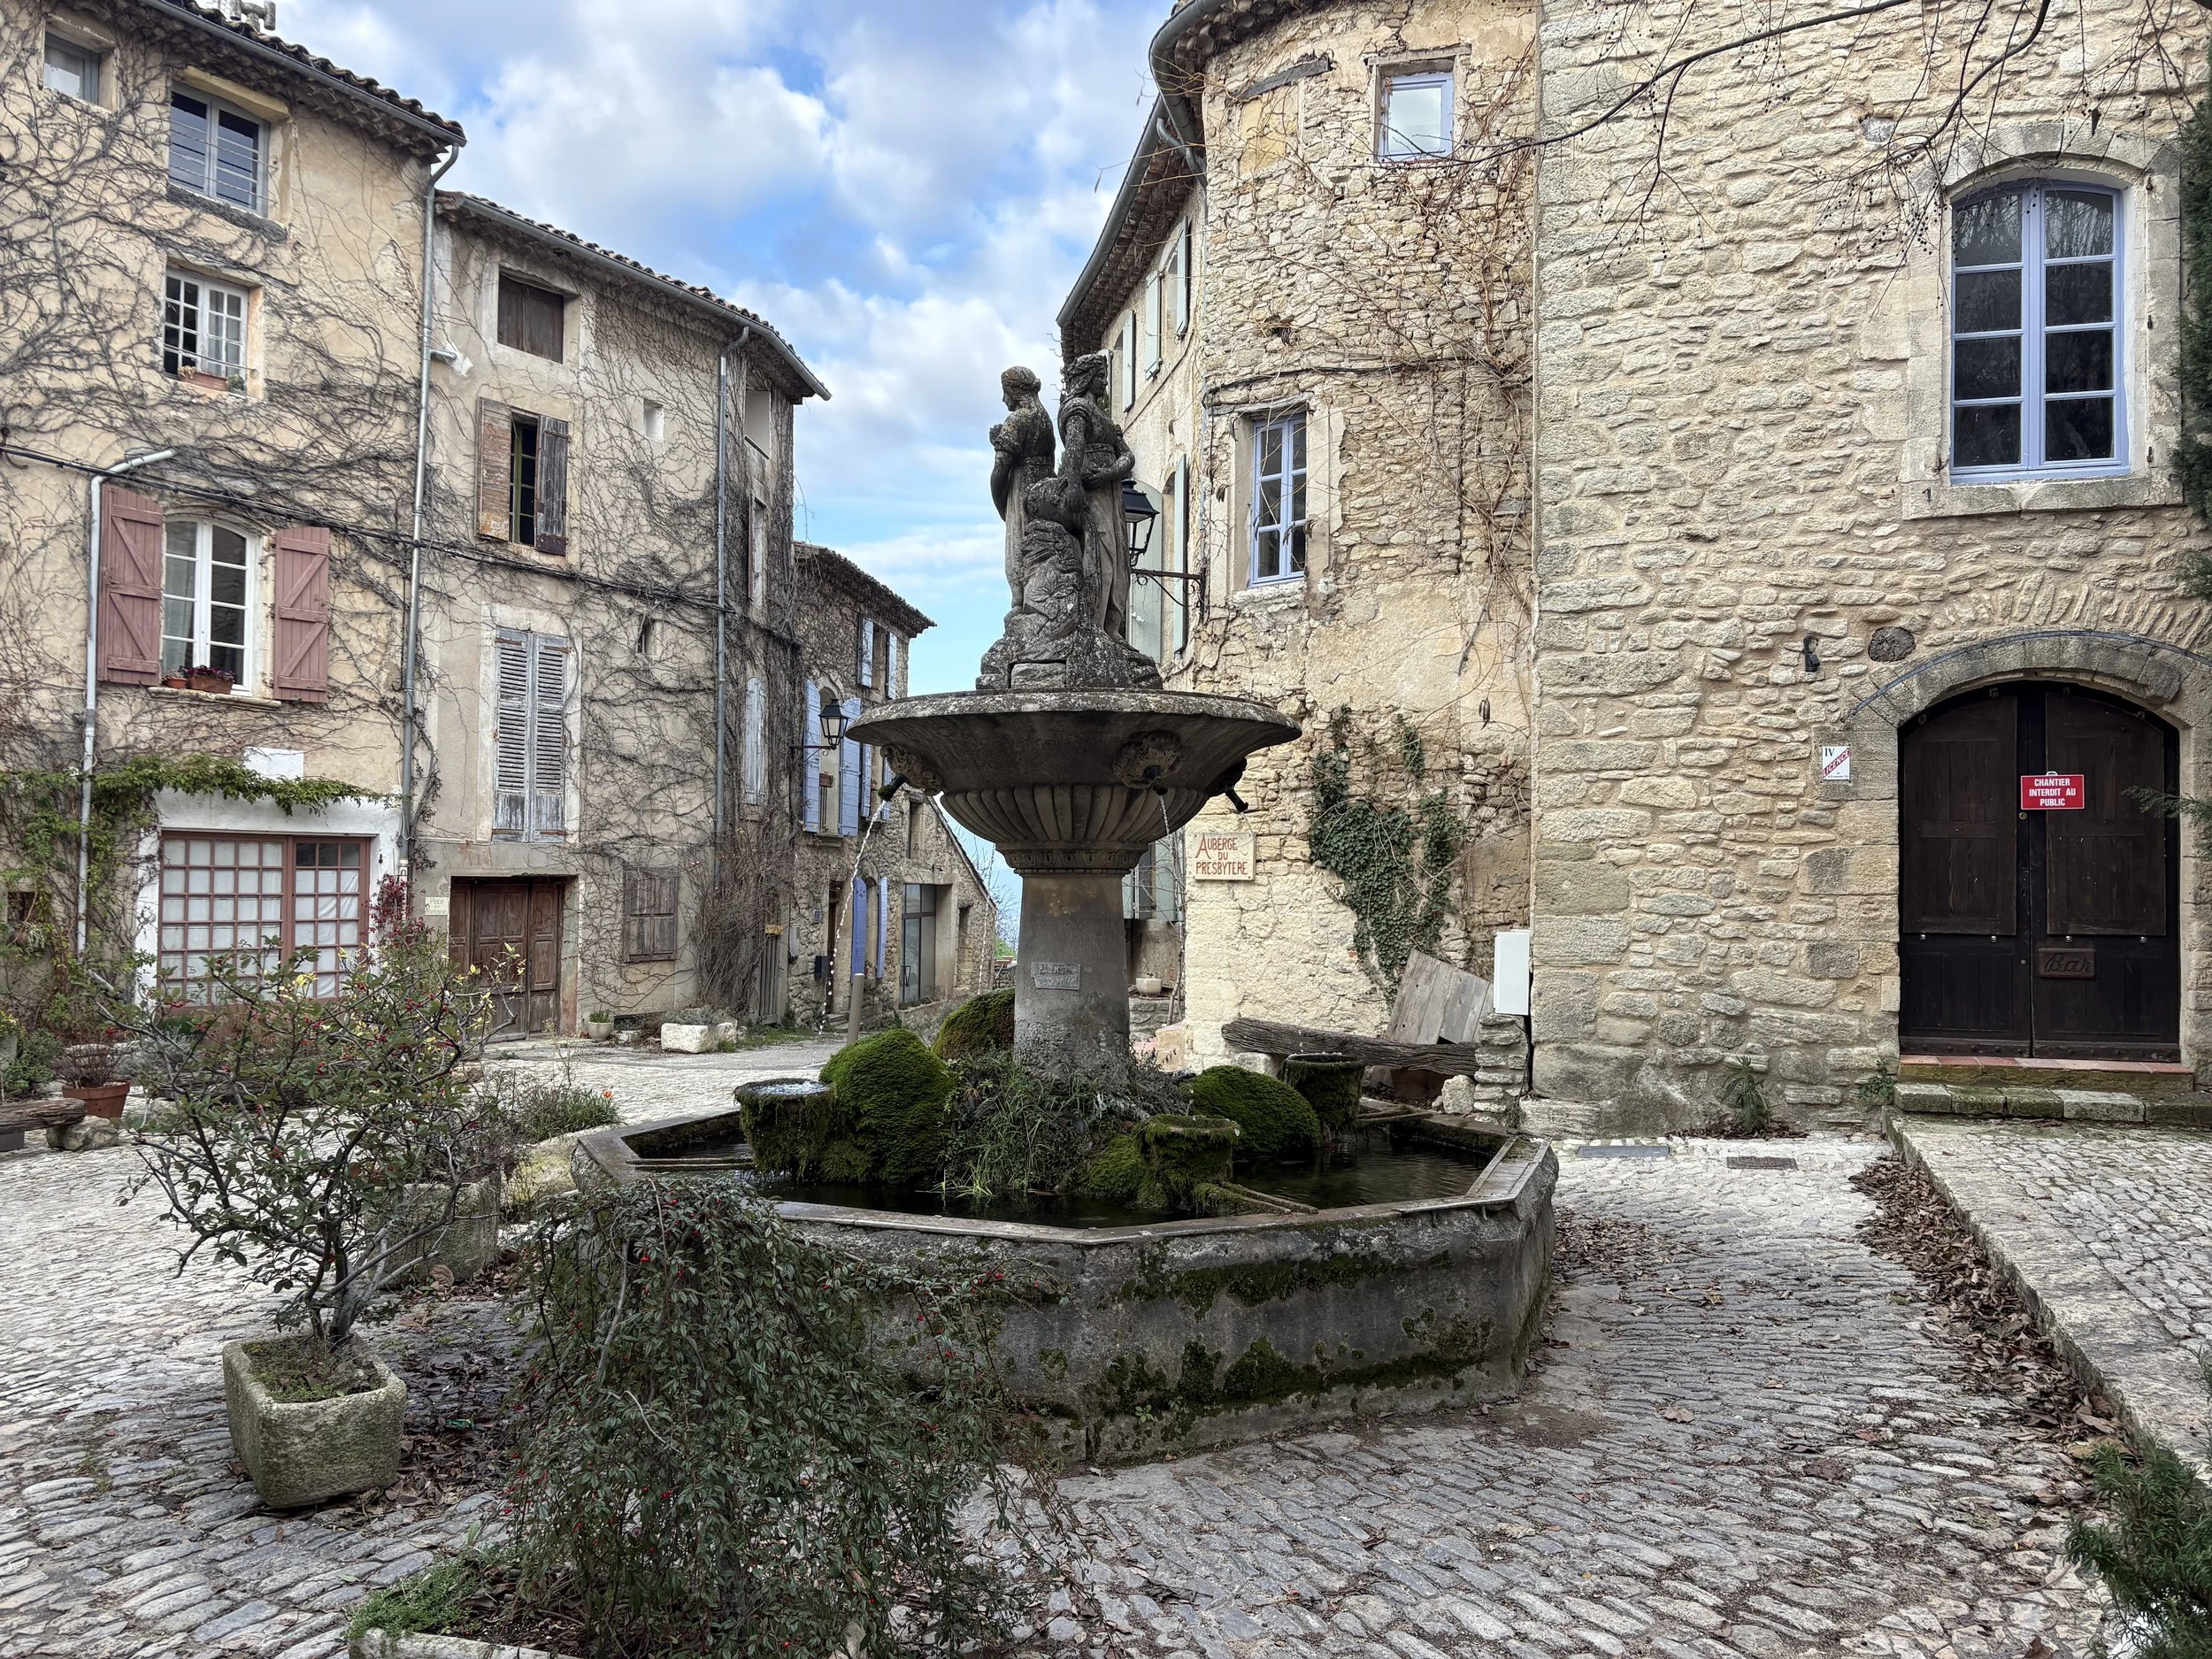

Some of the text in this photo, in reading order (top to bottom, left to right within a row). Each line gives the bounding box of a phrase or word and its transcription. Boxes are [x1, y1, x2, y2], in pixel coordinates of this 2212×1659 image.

[1824, 748, 1835, 757] IV
[1823, 749, 1850, 776] LICENCE
[2034, 778, 2070, 787] CHANTIER
[2065, 787, 2077, 796] AU
[1194, 833, 1238, 859] AUBERGE
[1217, 851, 1228, 860] DU
[1195, 861, 1248, 875] PRESBYTERE
[2044, 952, 2093, 972] Bar
